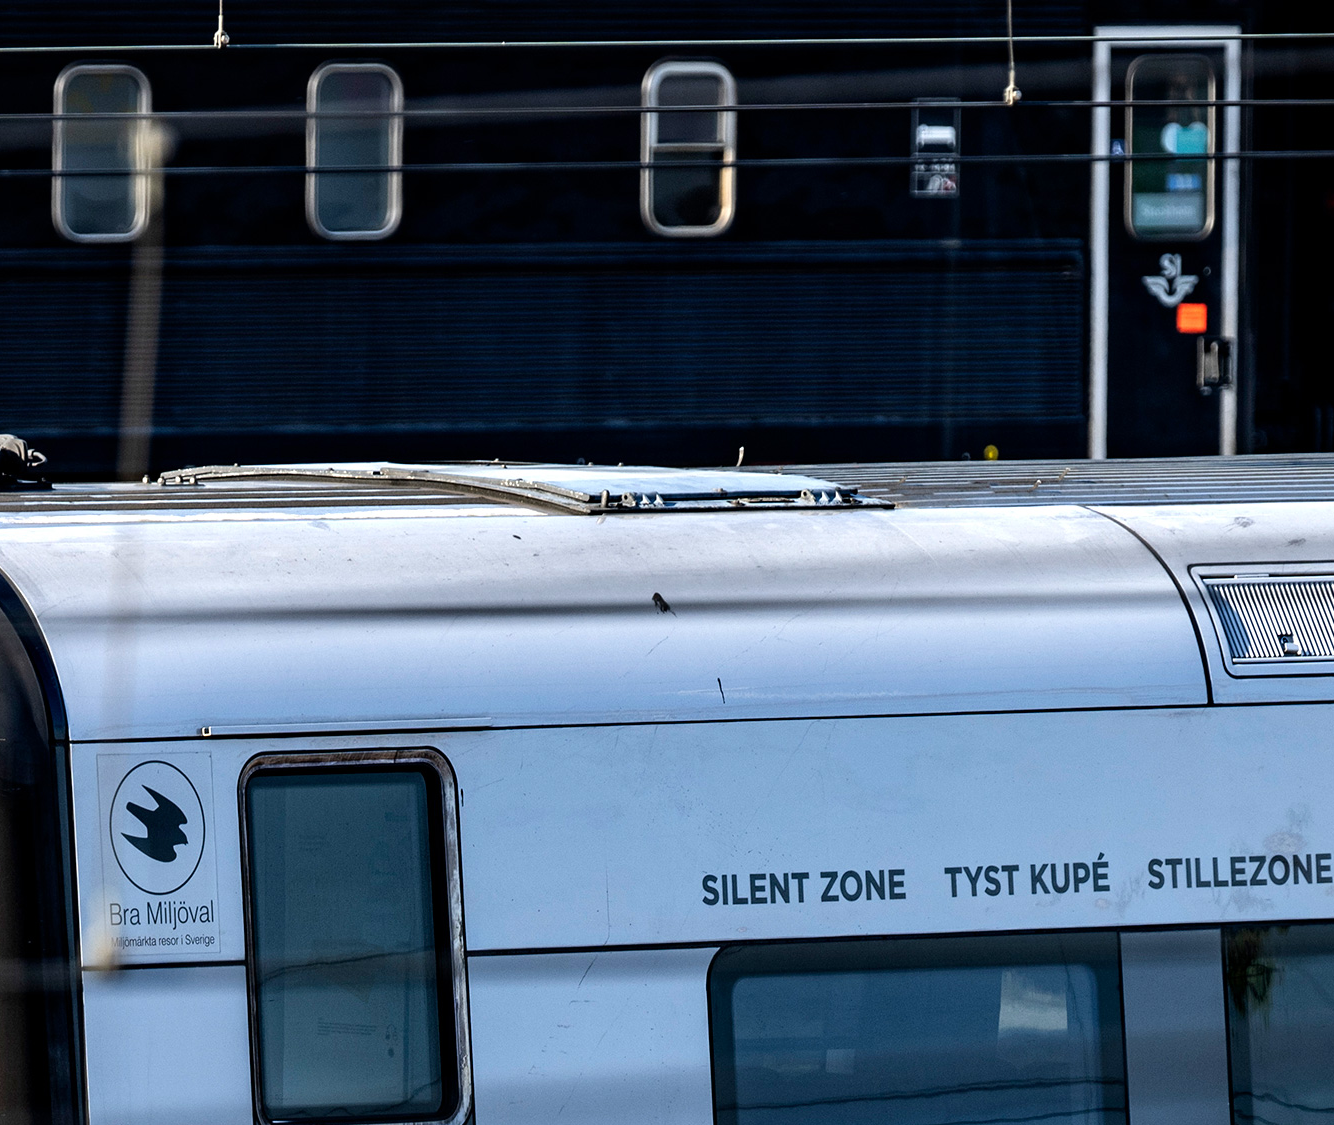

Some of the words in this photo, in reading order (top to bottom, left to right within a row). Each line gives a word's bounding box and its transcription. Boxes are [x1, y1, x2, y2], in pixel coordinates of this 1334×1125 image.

[703, 872, 809, 905] SILENT
[820, 869, 906, 902] ZONE
[945, 865, 1019, 897] TYST
[1030, 852, 1110, 894] KUPÉ
[1148, 853, 1332, 889] STILLEZONE
[110, 902, 141, 926] Bra
[147, 899, 215, 930] Miljöval
[159, 936, 179, 946] resor
[185, 933, 216, 948] Sverige
